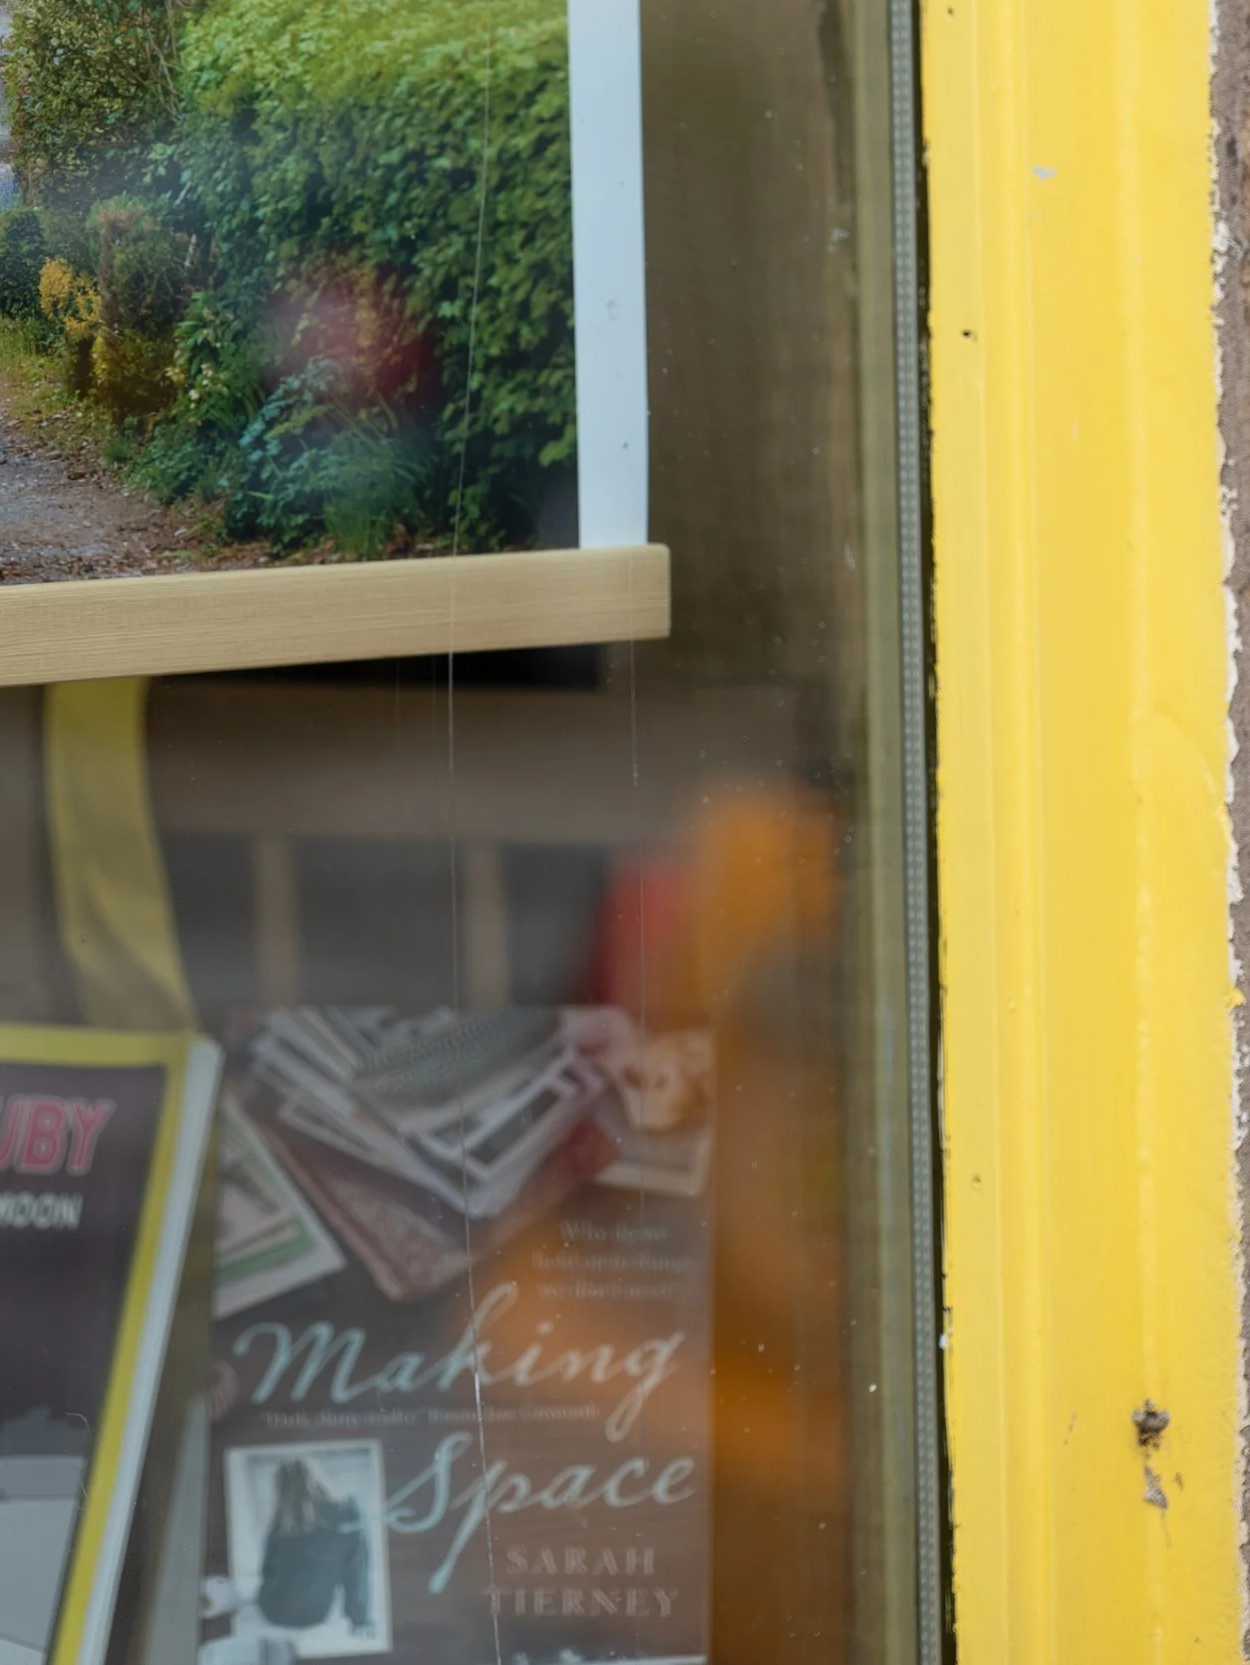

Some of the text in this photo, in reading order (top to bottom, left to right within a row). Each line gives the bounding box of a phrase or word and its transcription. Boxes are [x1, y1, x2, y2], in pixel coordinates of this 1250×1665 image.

[233, 1281, 686, 1442] Making
[382, 1432, 695, 1594] Space
[506, 1546, 655, 1575] SARAH
[480, 1587, 680, 1618] TIERNEY
